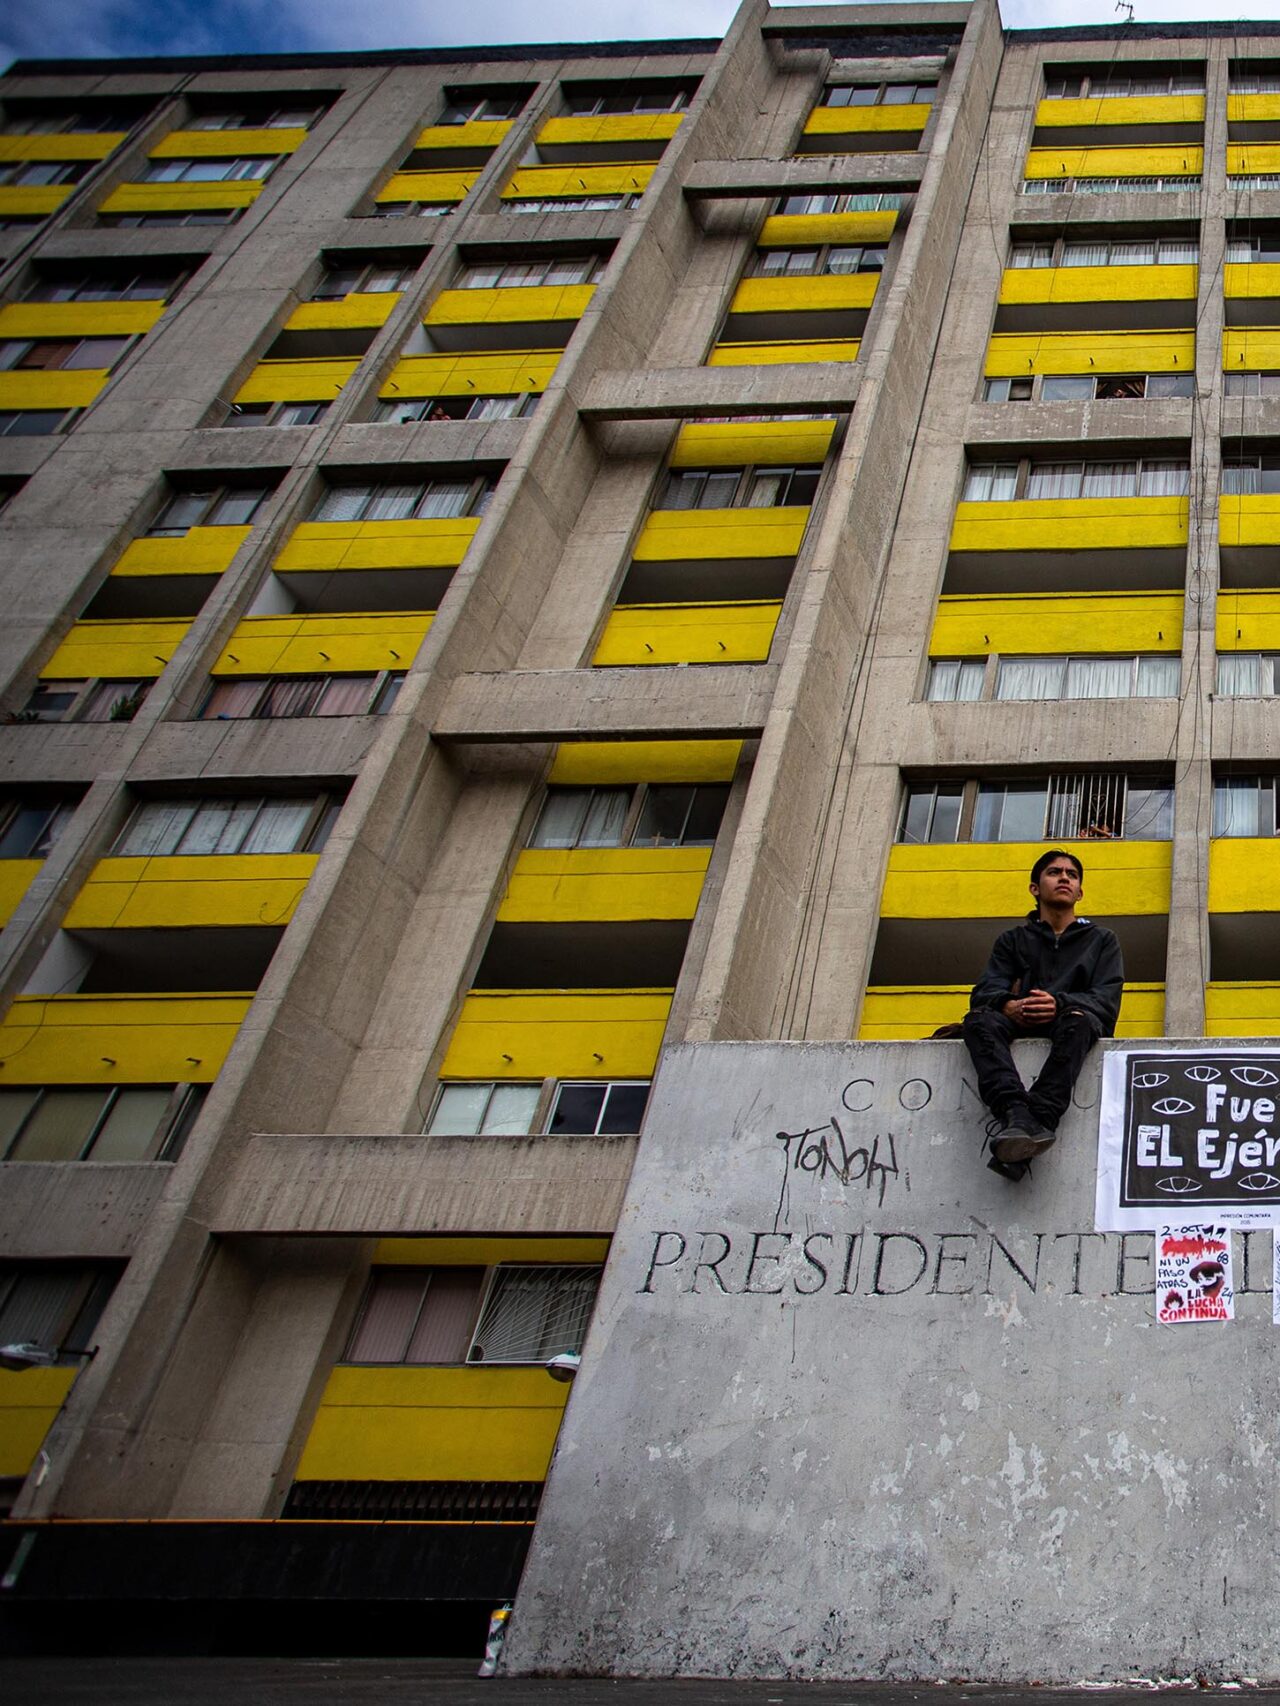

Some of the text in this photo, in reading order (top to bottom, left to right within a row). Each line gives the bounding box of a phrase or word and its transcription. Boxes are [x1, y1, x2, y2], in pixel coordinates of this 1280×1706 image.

[1206, 1083, 1276, 1123] Fue
[1136, 1123, 1184, 1168] EL
[635, 1229, 1155, 1297] PRESIDENTE
[1160, 1257, 1190, 1267] NI UN
[1158, 1269, 1185, 1278] PASO
[1187, 1289, 1201, 1299] LA
[1188, 1298, 1224, 1308] LUCHA
[1160, 1308, 1228, 1321] CONTINUA
